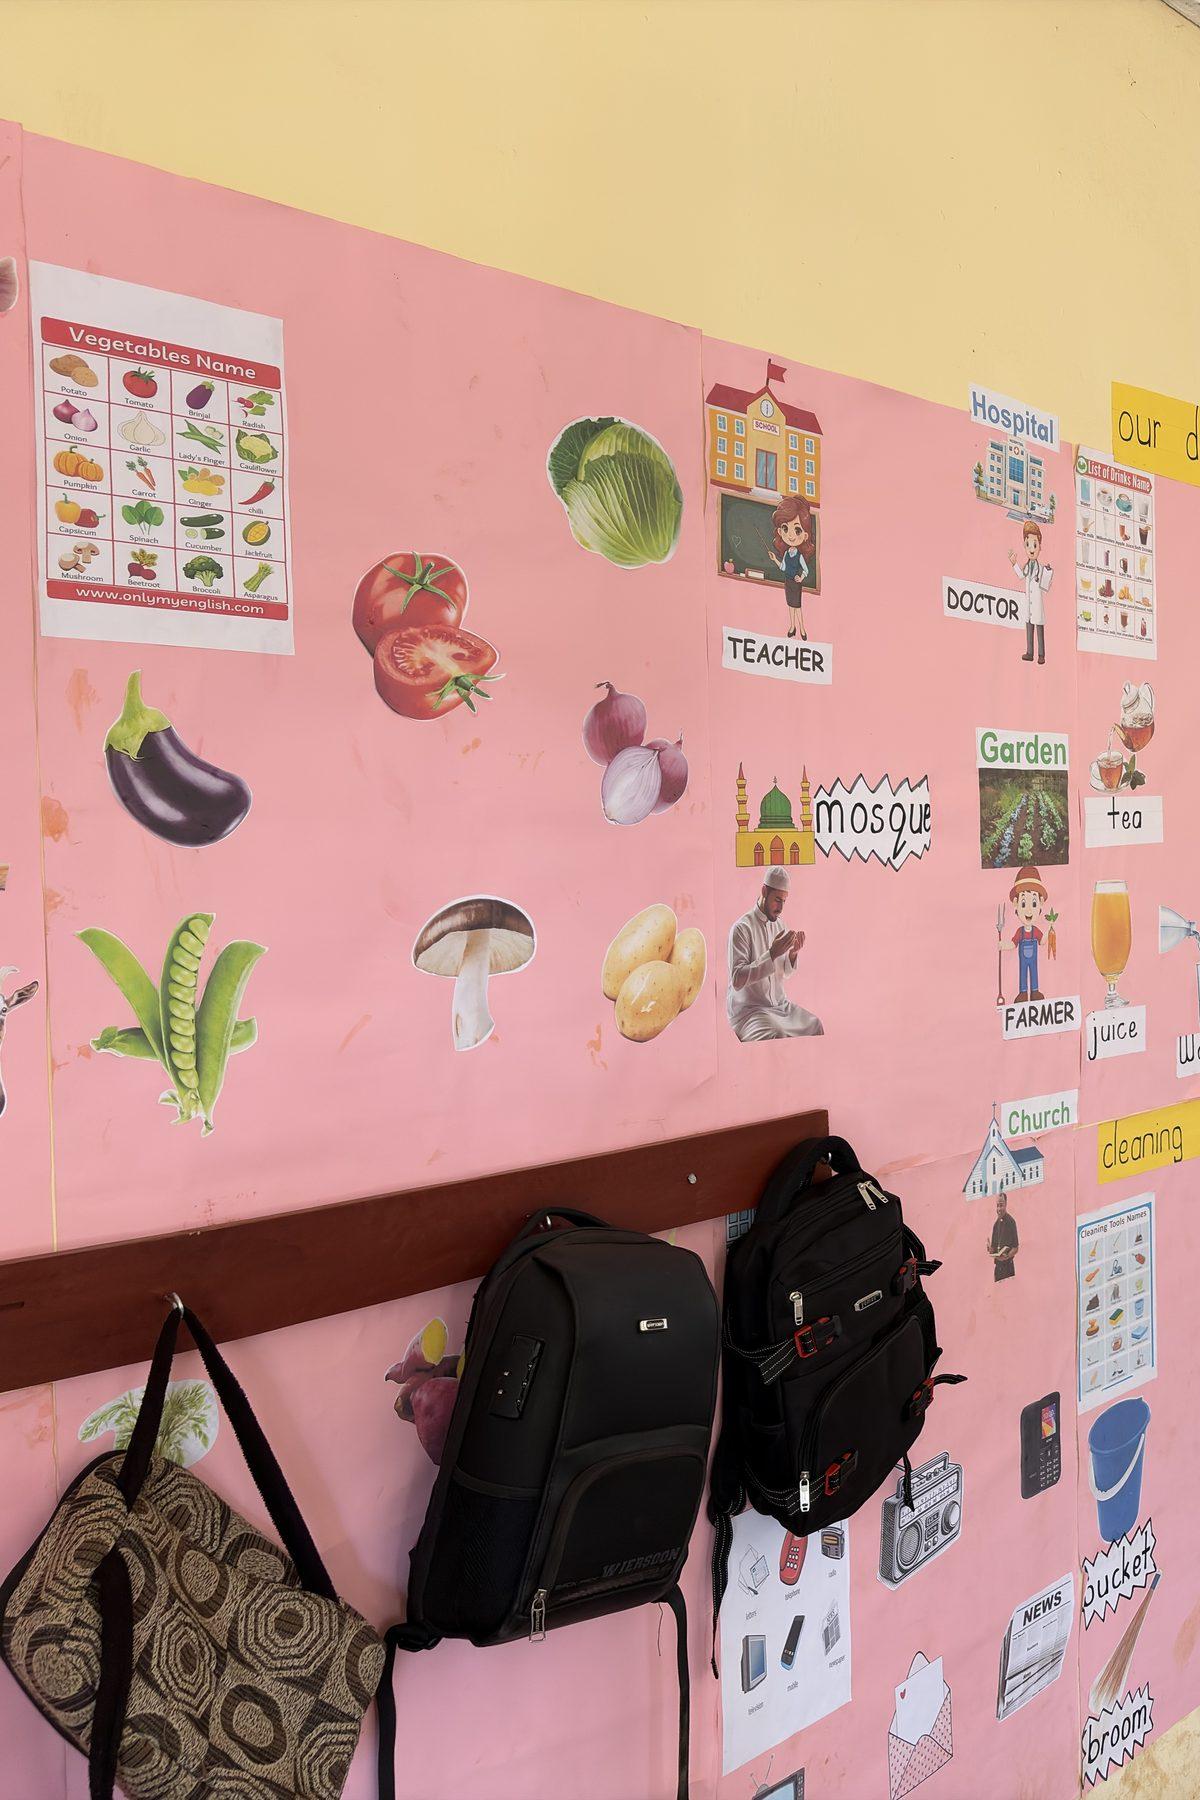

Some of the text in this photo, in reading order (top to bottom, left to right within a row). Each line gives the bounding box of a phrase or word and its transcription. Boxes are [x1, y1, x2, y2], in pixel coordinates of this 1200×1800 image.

[69, 325, 257, 379] Vegetables Name
[61, 386, 88, 397] Potato
[124, 397, 154, 408] Tomato
[188, 409, 210, 420] Brinjal
[971, 391, 1055, 443] Hospital
[242, 420, 266, 430] Radish
[754, 420, 778, 434] SCHOOL
[1118, 411, 1161, 448] our
[64, 433, 88, 444] Onion
[129, 444, 151, 453] Garlic
[178, 452, 203, 464] Lady's
[240, 462, 277, 474] Cauliflower
[1087, 461, 1150, 492] List of Drinks Name
[63, 480, 98, 492] Pumpkin
[132, 489, 156, 499] Carrot
[58, 526, 97, 537] Capsicum
[129, 534, 159, 545] Spinach
[185, 542, 222, 552] Cucumber
[244, 549, 273, 559] Jackfruit
[61, 572, 104, 582] Mushroom
[128, 580, 161, 589] Beetroot
[192, 585, 221, 594] Broccoli
[76, 587, 264, 615] www.onlymyenglish.com
[243, 591, 278, 601] Asparagus
[947, 586, 1019, 620] DOCTOR
[728, 636, 824, 672] TEACHER
[980, 731, 1066, 765] Garden
[1107, 797, 1141, 830] tea
[817, 799, 930, 860] mosque
[1005, 1001, 1074, 1031] FARMER
[1088, 1011, 1137, 1061] juice
[1009, 1101, 1070, 1134] Church
[1103, 1120, 1184, 1168] cleaning
[1081, 1210, 1147, 1239] Cleaning Tools Names
[1022, 1591, 1062, 1627] NEWS
[1088, 1705, 1146, 1764] broom
